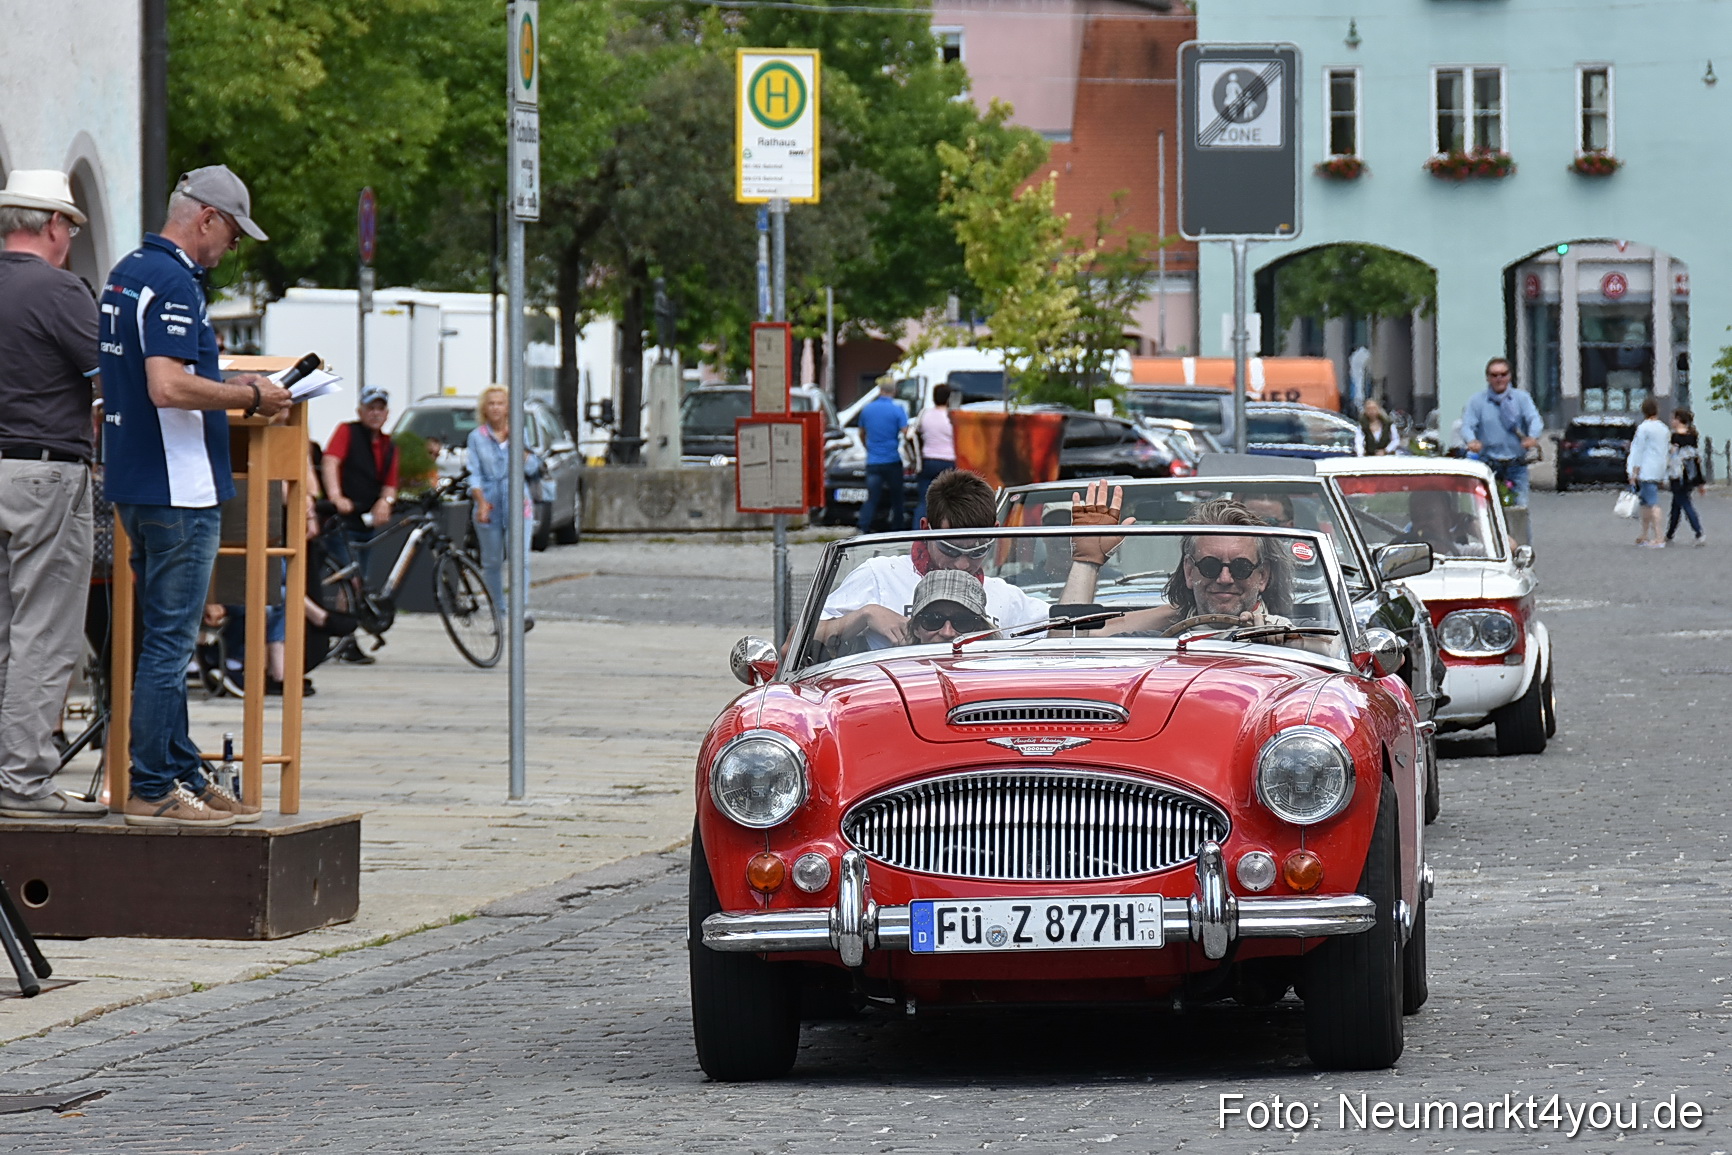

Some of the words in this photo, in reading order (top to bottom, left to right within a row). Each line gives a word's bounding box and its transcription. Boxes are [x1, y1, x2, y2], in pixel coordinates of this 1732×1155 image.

[766, 77, 788, 113] H
[1218, 127, 1262, 142] ZONE
[757, 137, 796, 146] Rathaus
[1138, 902, 1154, 913] 04
[1011, 905, 1033, 943] Z
[1045, 903, 1135, 942] 877H
[918, 932, 927, 943] D
